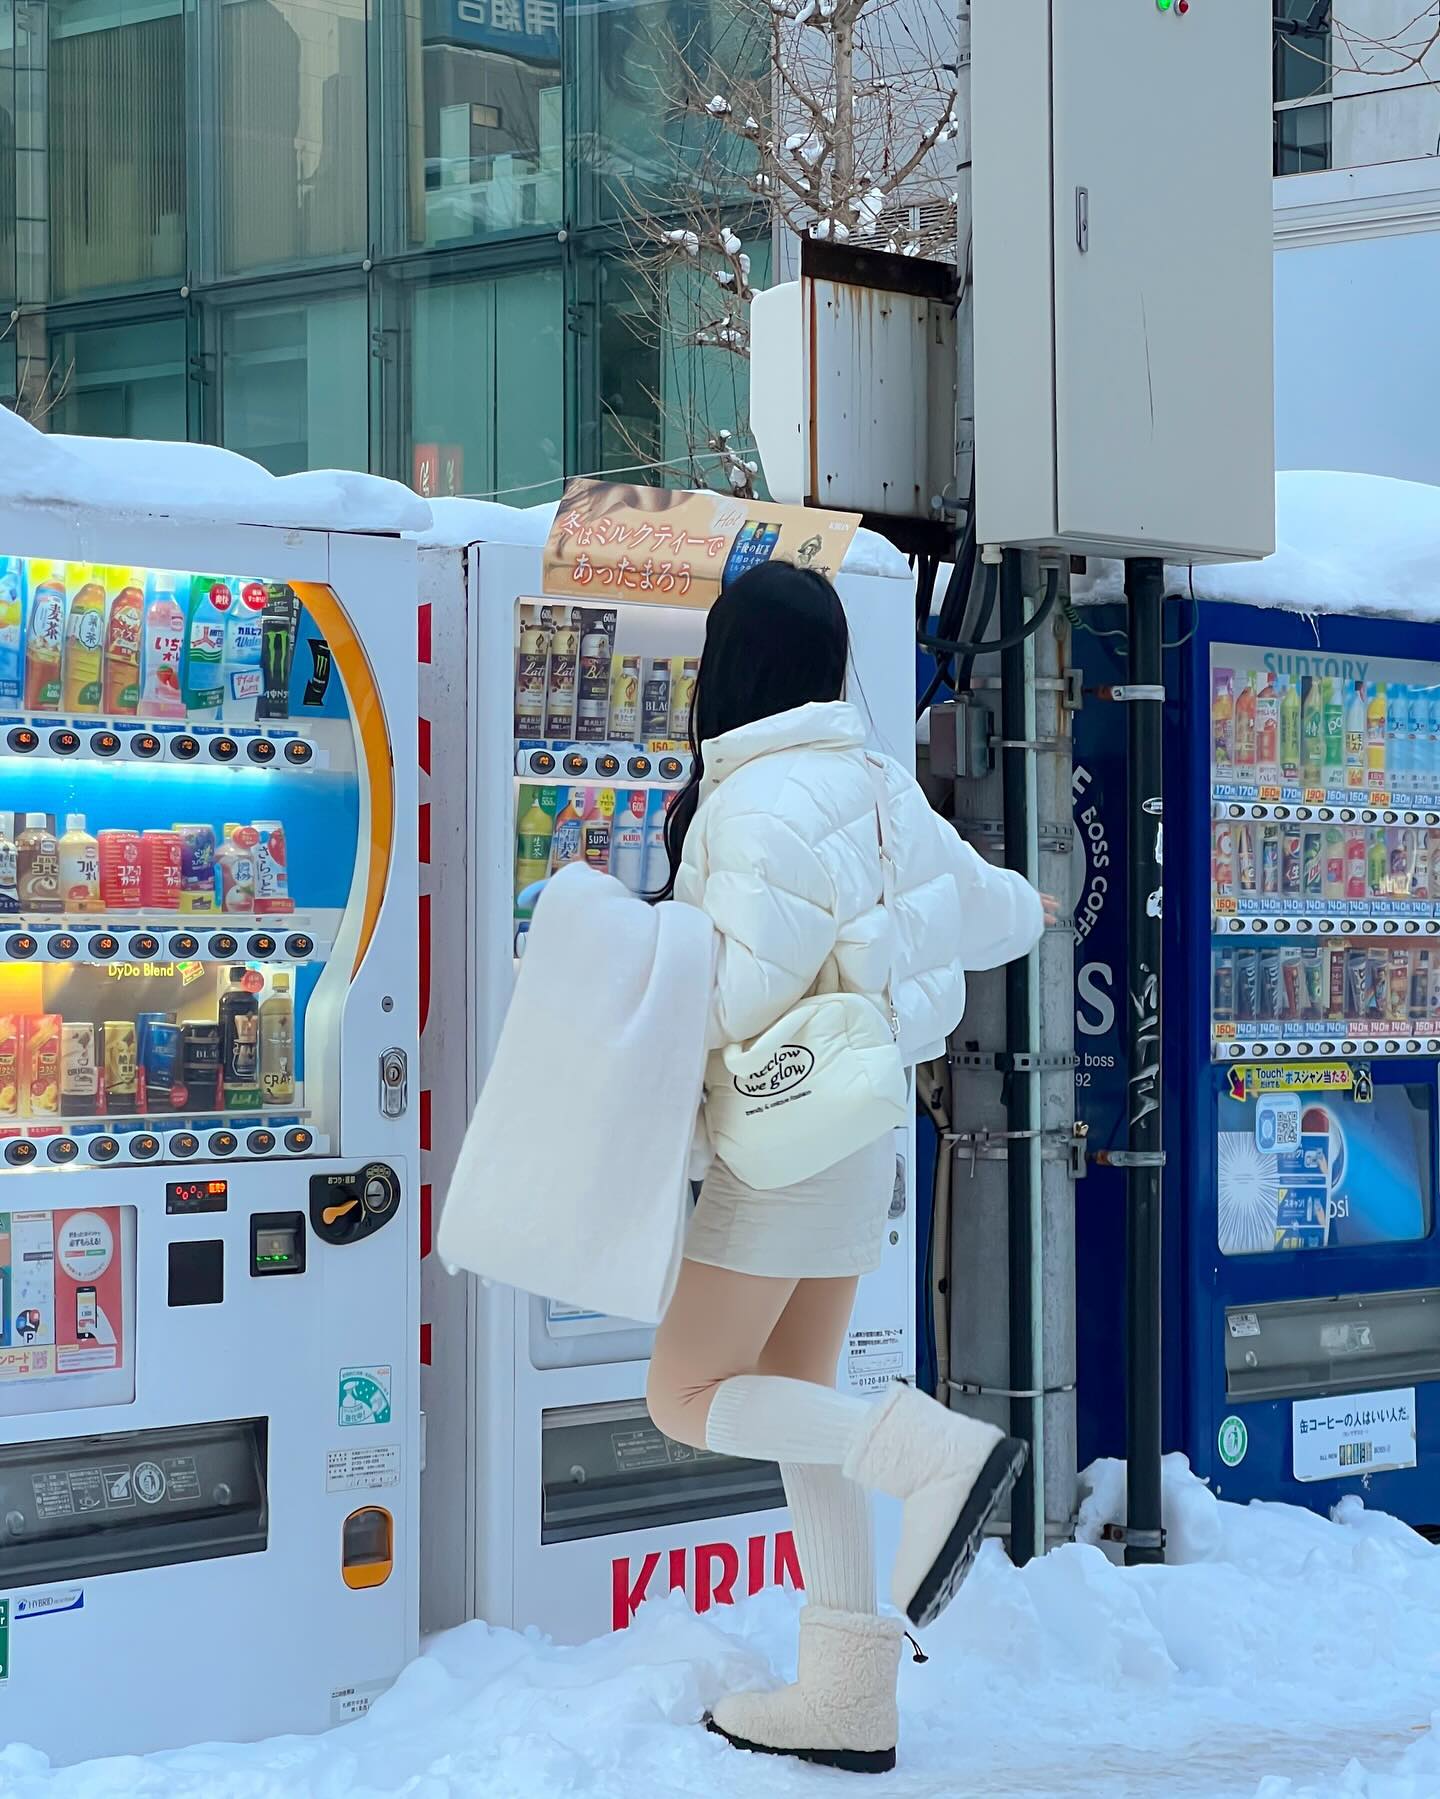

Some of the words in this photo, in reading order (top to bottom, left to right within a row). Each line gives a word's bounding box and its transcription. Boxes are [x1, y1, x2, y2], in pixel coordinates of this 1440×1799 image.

[560, 510, 724, 556] 冬はミルクティーで
[573, 553, 692, 594] あったまろう
[46, 603, 61, 641] 麦茶
[154, 636, 183, 652] いち
[1081, 806, 1110, 868] BOSS
[108, 962, 140, 981] DyDo
[143, 962, 174, 977] Blend
[1084, 1052, 1115, 1067] boss
[1256, 1067, 1284, 1079] Touch!
[745, 1082, 767, 1093] we
[769, 1062, 806, 1090] glow
[26, 1334, 34, 1344] P
[1299, 1407, 1410, 1434] 缶コーヒーの人はいい人だ。
